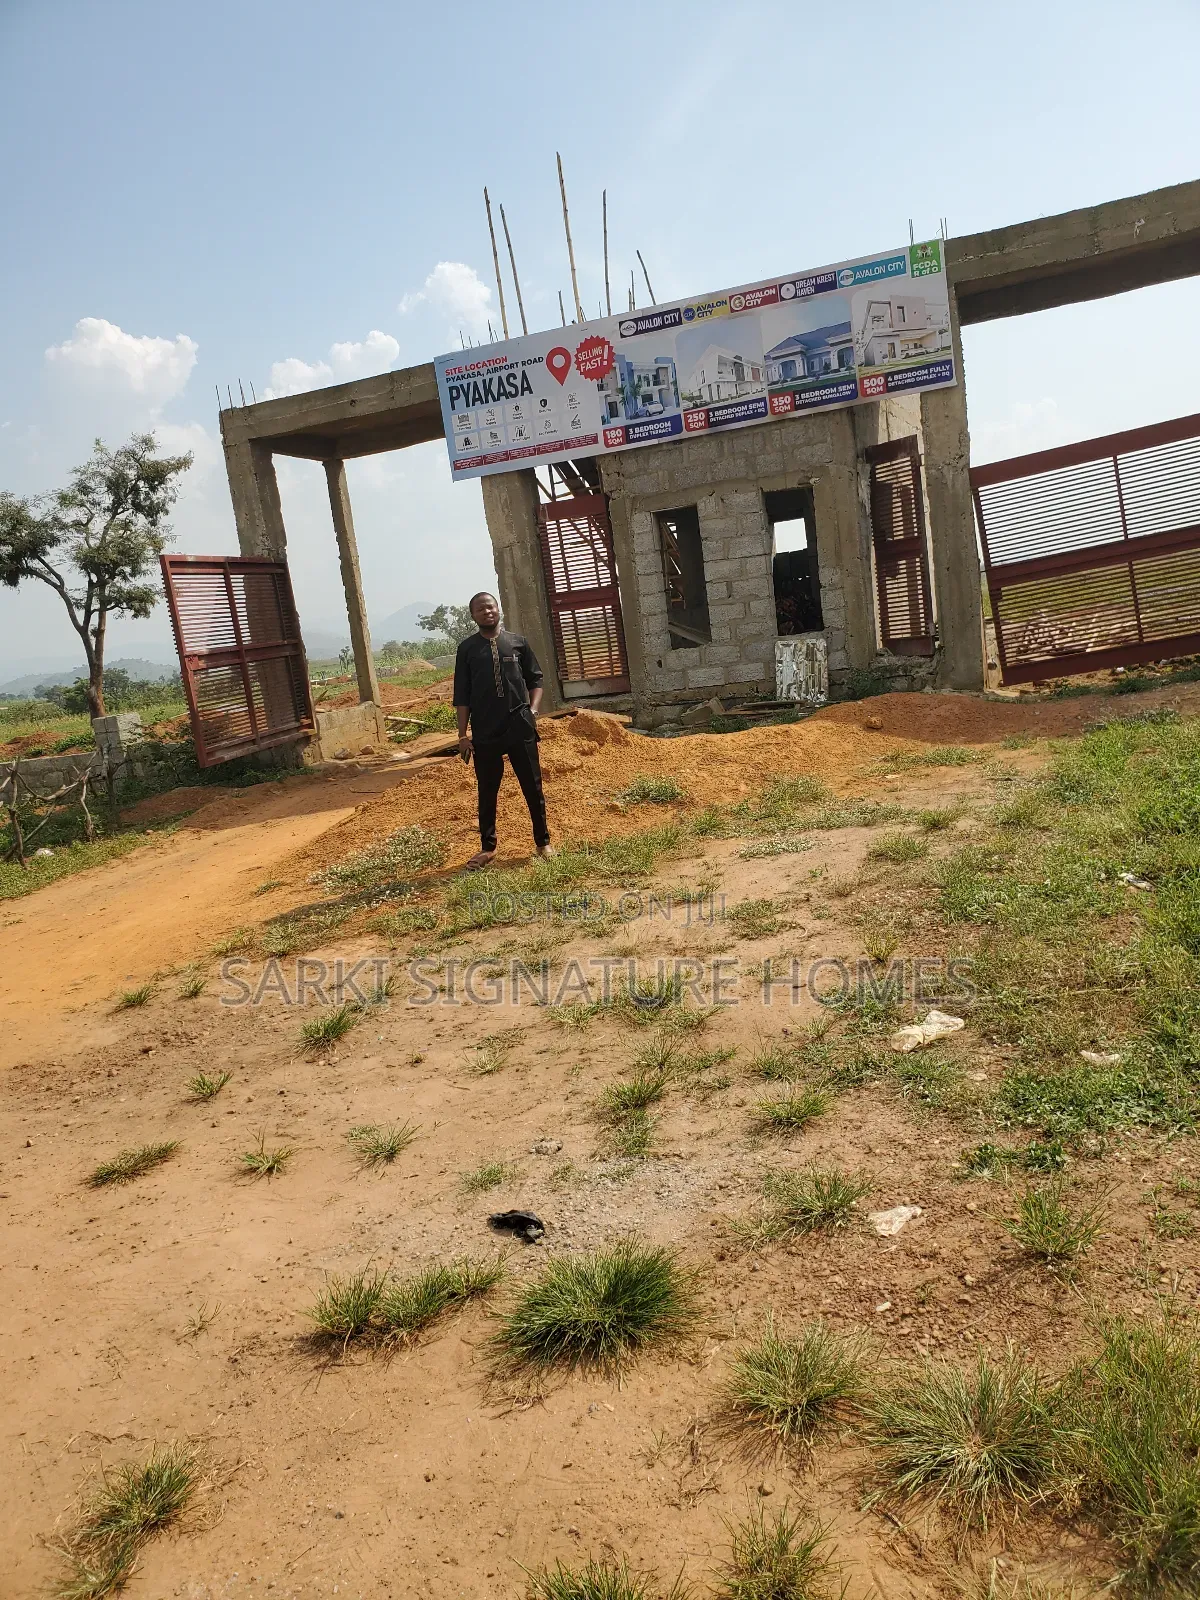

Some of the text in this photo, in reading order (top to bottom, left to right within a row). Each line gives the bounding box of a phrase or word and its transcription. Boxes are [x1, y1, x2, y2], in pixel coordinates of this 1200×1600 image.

[855, 261, 905, 279] AVALON CITY
[913, 259, 938, 270] FCDA
[795, 277, 816, 289] DREAM
[745, 288, 776, 300] AVALON
[796, 286, 815, 297] HAVEN
[696, 300, 728, 312] AVALON
[745, 298, 762, 307] CITY
[697, 309, 714, 318] CITY
[637, 316, 663, 331] AVALON
[663, 312, 680, 325] CITY
[578, 346, 603, 361] SELLING
[445, 356, 508, 376] SITE LOCATION
[446, 356, 544, 383] PYAKASA, AIRPORT ROAD
[893, 369, 929, 381] BEDROOM
[930, 365, 951, 374] FULLY
[863, 377, 884, 388] 500
[448, 370, 533, 411] PYAKASA
[801, 387, 837, 399] BEDROOM
[837, 383, 855, 392] SEMI
[822, 390, 852, 400] BUNGALOW
[866, 386, 883, 395] SQM
[771, 395, 792, 407] 350
[714, 404, 747, 417] BEDROOM
[748, 401, 765, 410] SEMI
[774, 405, 791, 413] SQM
[686, 412, 706, 423] 250
[634, 421, 672, 434] BEDROOM
[689, 421, 705, 429] SQM
[605, 428, 622, 439] 180
[607, 437, 623, 445] SQM
